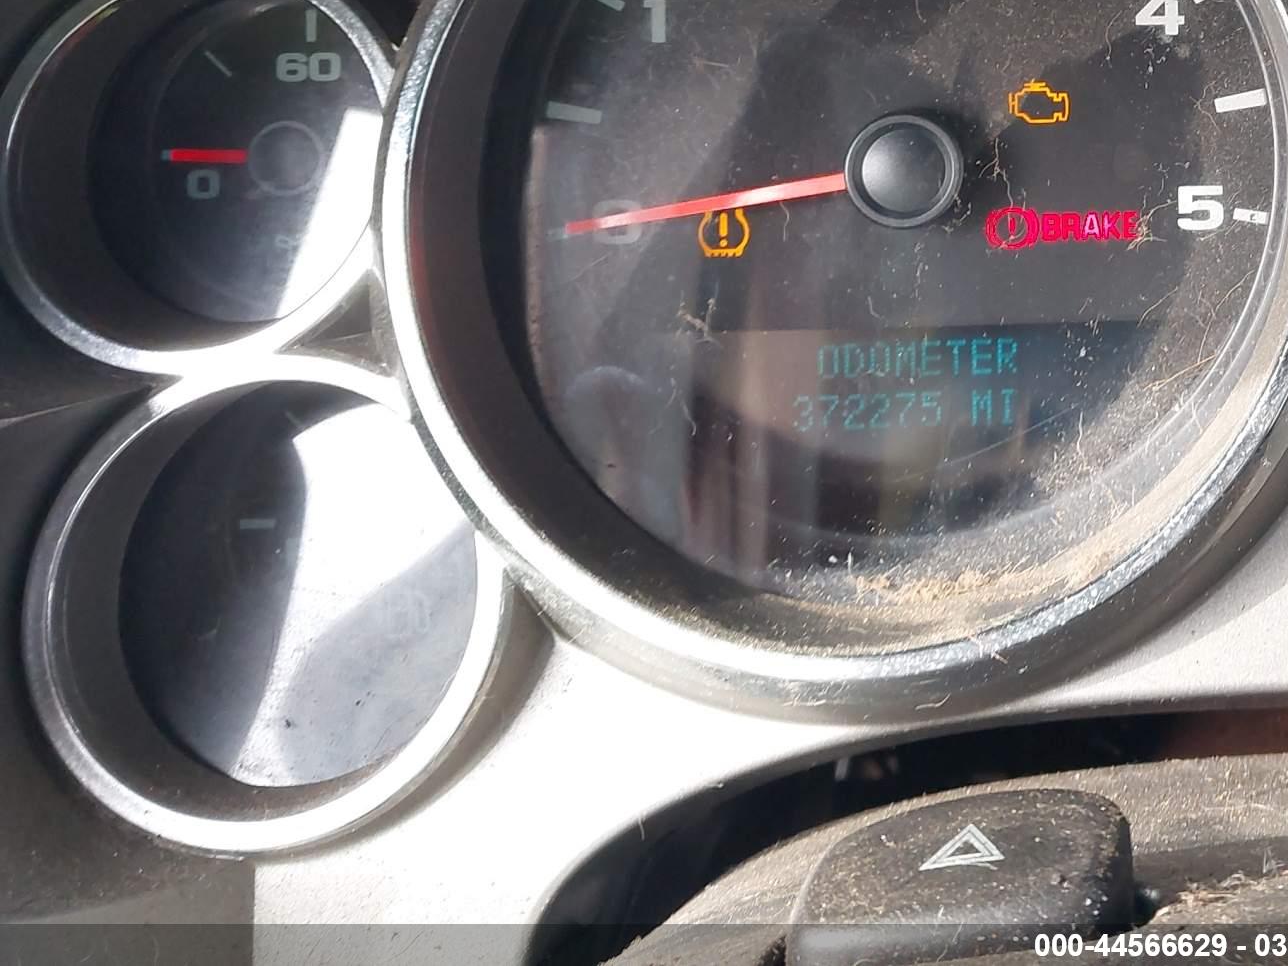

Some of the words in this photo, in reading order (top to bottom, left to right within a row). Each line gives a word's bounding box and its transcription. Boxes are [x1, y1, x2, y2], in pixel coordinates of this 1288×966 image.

[275, 52, 342, 82] 60
[186, 169, 220, 199] 0
[1176, 186, 1225, 231] 5
[1041, 212, 1137, 242] BRAKE
[817, 338, 1018, 379] ODOMETER
[793, 391, 942, 432] 372275
[970, 387, 1017, 427] MI
